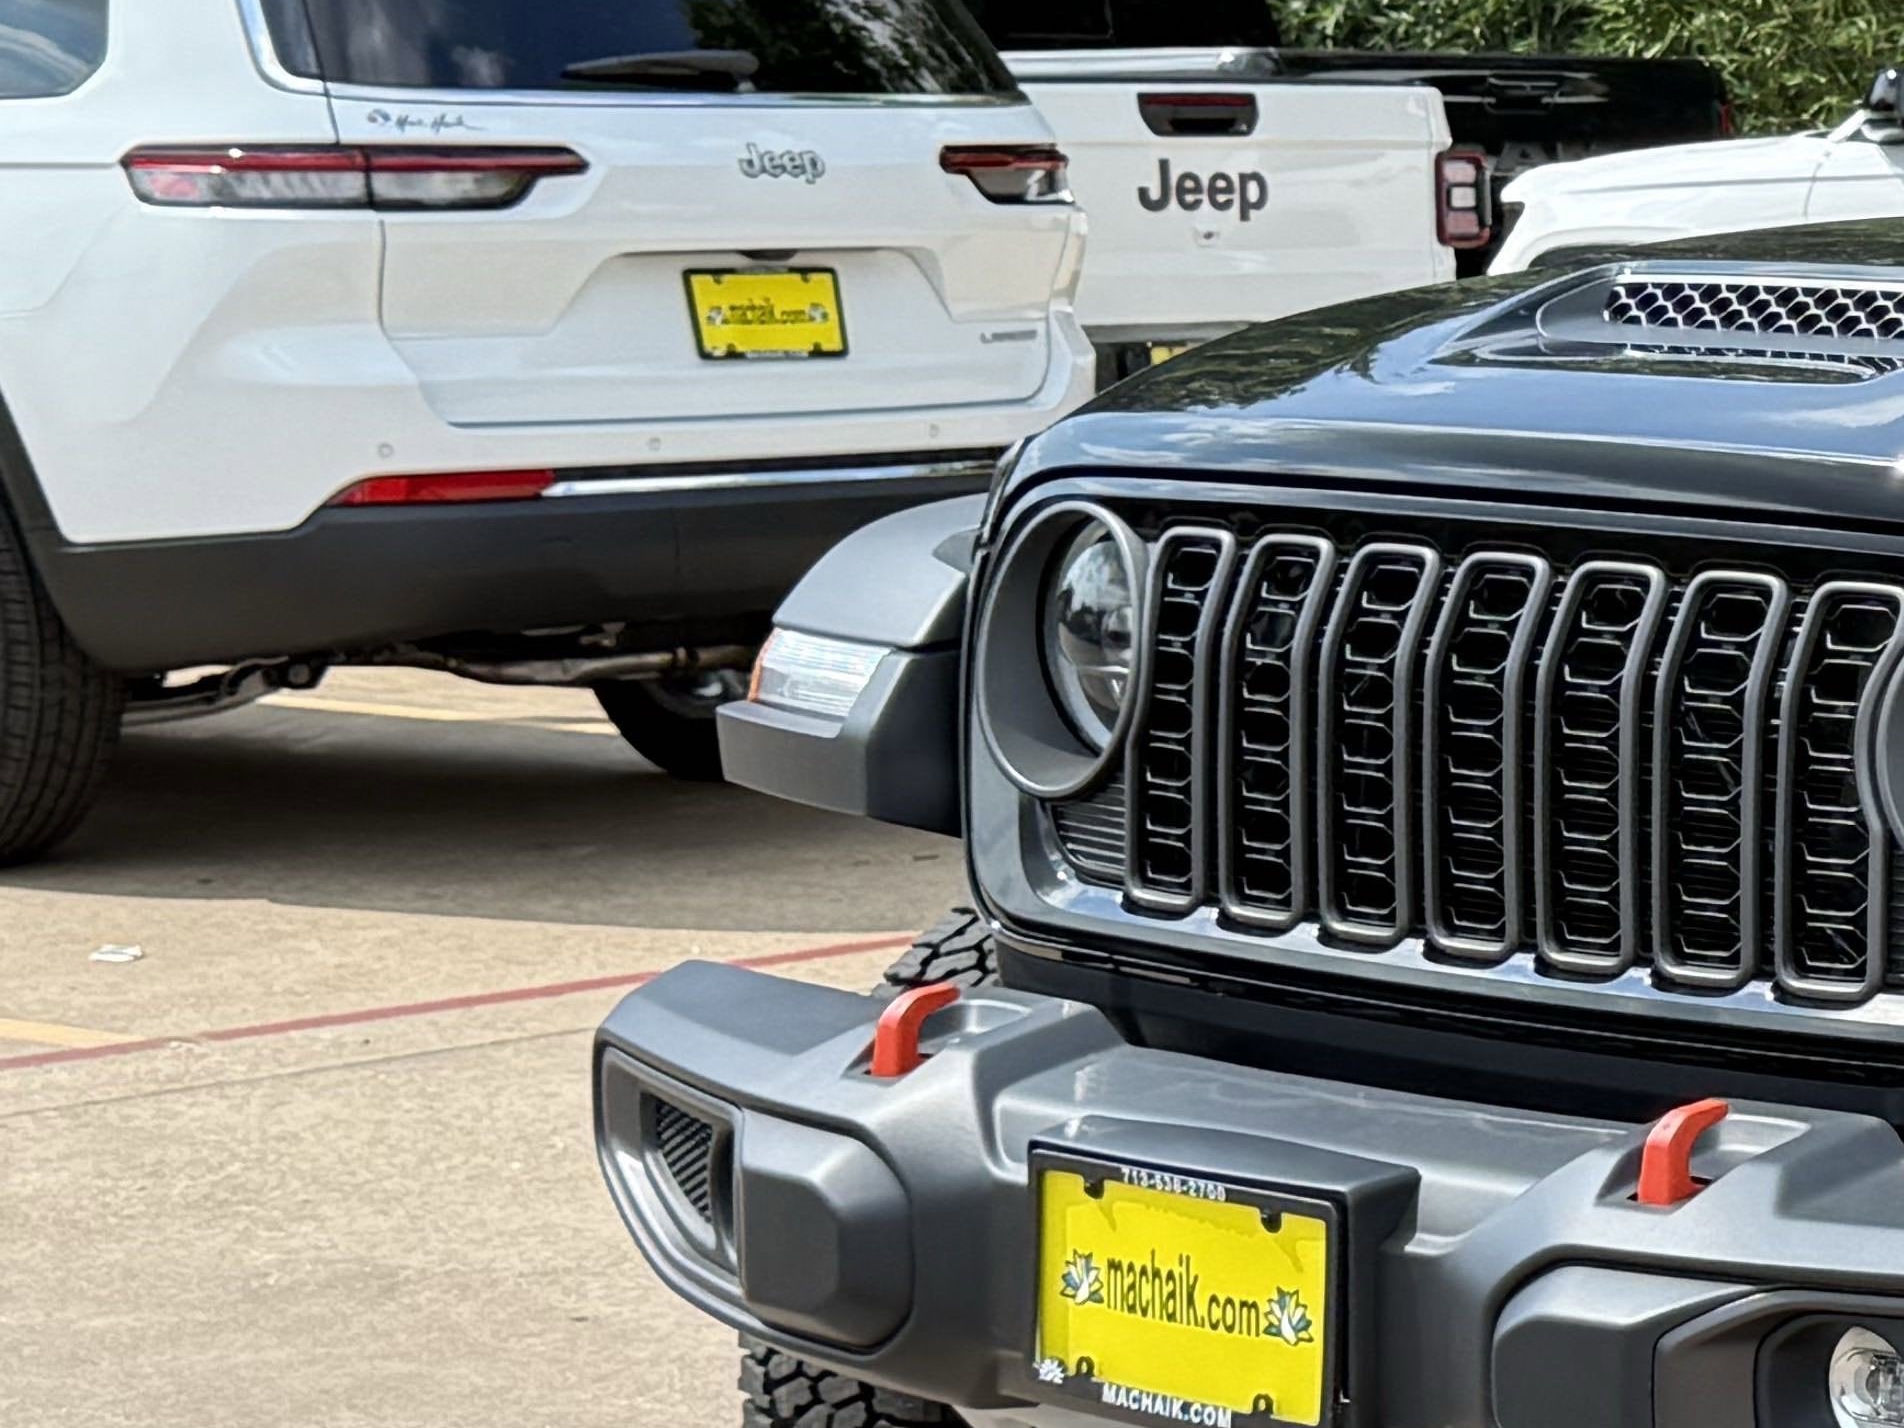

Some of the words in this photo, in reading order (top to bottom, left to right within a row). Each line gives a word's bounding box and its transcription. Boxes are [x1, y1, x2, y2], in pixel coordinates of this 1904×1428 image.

[738, 142, 826, 185] Jeep
[1137, 158, 1268, 222] Jeep
[1106, 1249, 1261, 1338] machaik.com
